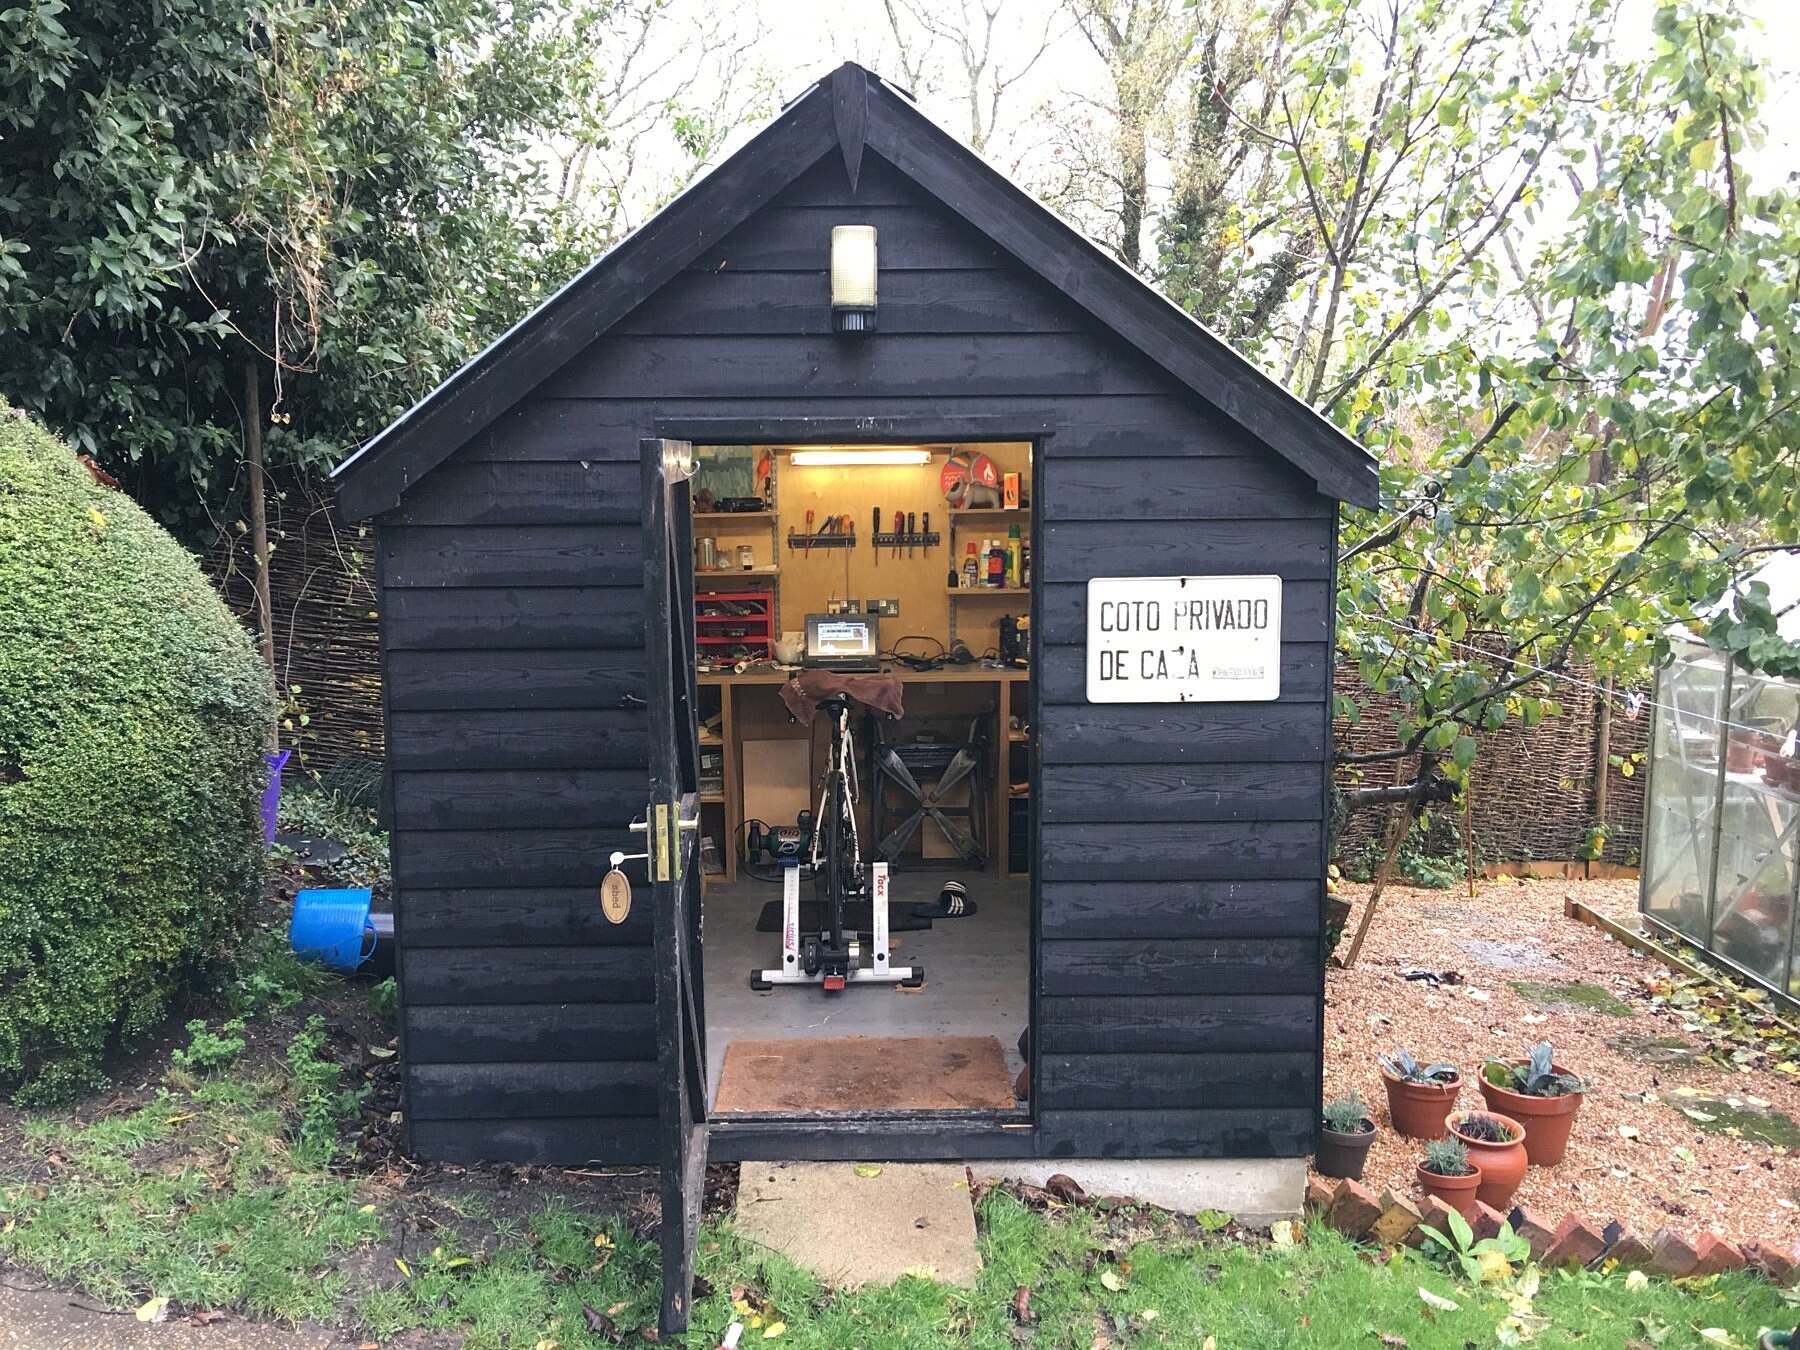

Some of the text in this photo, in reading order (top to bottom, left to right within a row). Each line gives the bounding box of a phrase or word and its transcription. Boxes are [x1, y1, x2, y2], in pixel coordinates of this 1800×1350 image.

[1100, 599, 1268, 632] COTO PRIVADO
[1100, 649, 1200, 680] DE CAA
[611, 884, 621, 908] shed
[877, 874, 886, 896] Tacx
